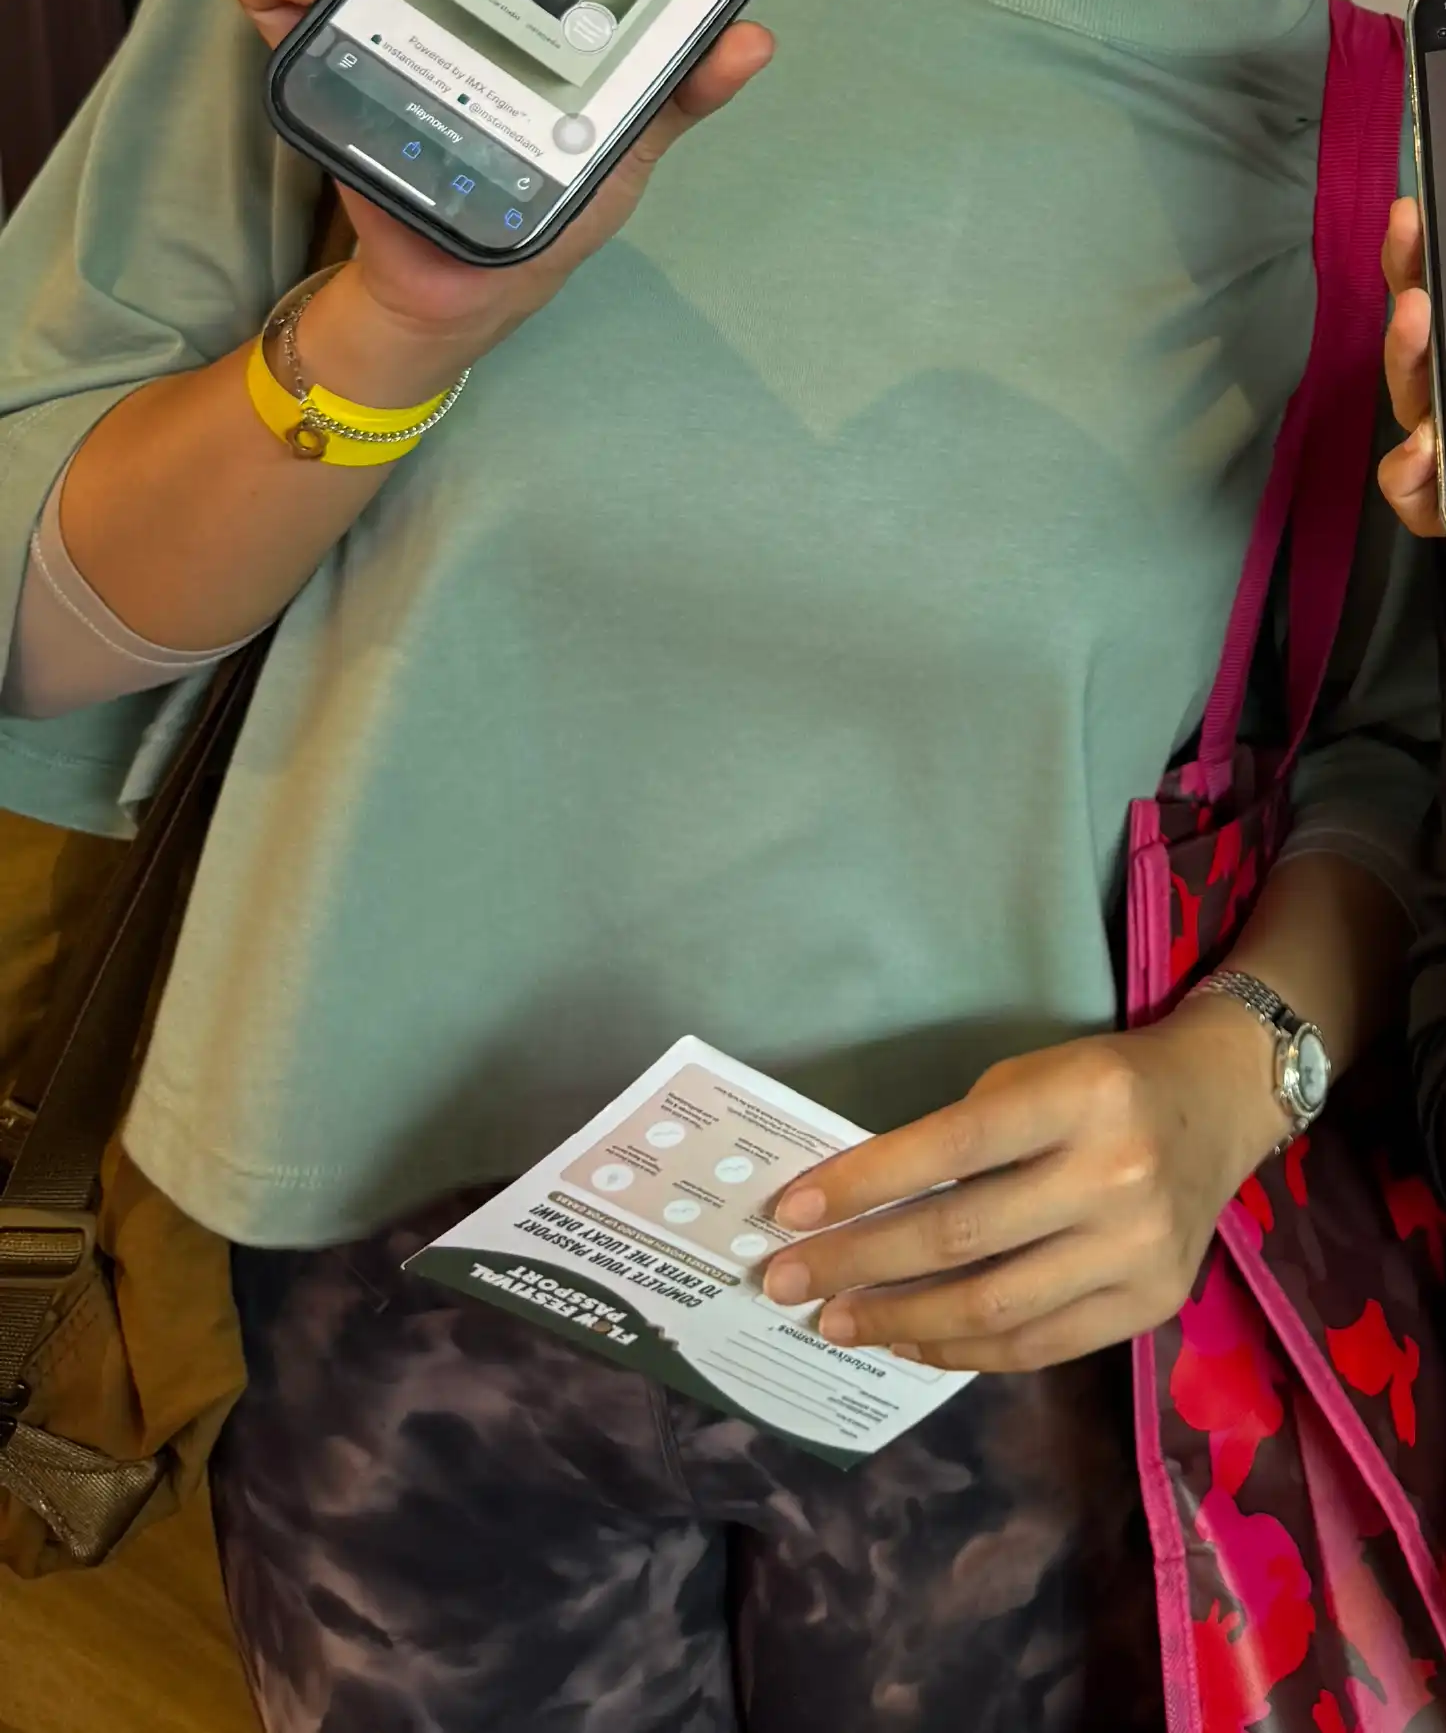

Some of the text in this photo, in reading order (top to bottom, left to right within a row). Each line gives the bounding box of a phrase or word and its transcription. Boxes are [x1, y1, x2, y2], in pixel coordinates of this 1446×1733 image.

[382, 41, 453, 94] instamedia.my
[408, 35, 451, 70] Powered
[451, 66, 466, 80] by
[465, 75, 488, 94] IMX
[405, 101, 464, 144] playnow.my
[514, 1218, 704, 1308] COMPLETE YOUR PASSPORT
[529, 1204, 723, 1300] TO ENTER THE LUCKY DRAW!
[469, 1263, 579, 1317] FESTIVAL
[506, 1266, 628, 1323] PASSPORT
[827, 1349, 886, 1378] exclusive
